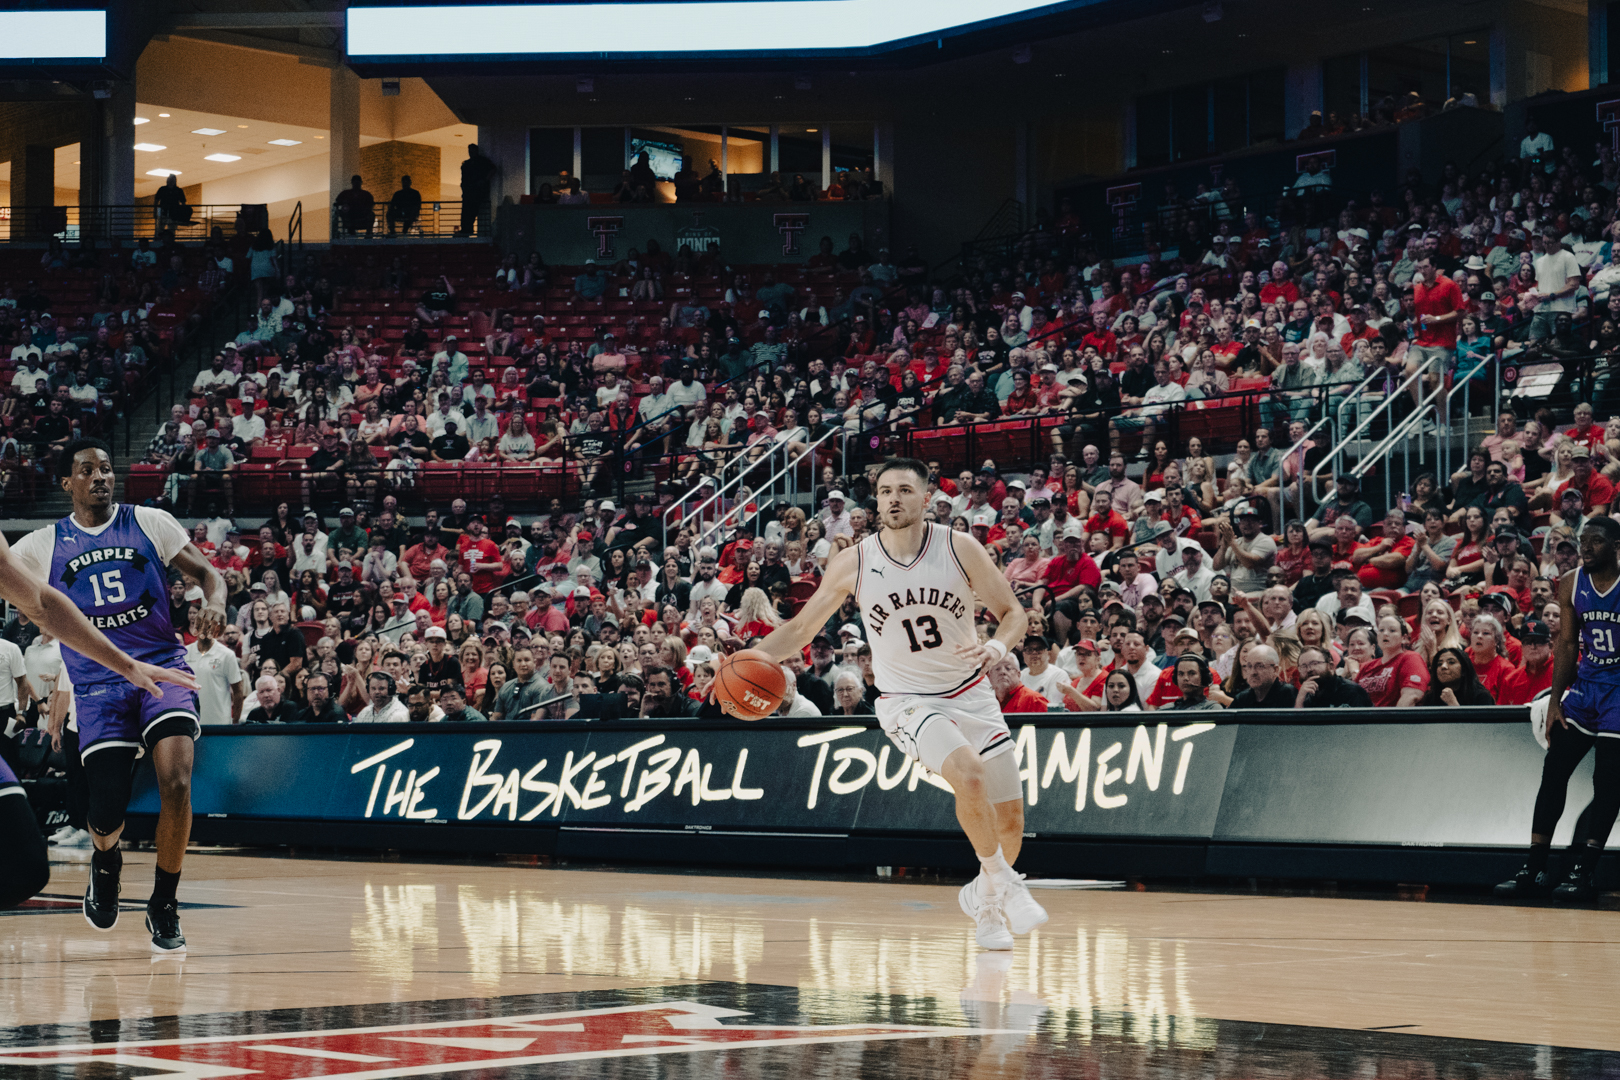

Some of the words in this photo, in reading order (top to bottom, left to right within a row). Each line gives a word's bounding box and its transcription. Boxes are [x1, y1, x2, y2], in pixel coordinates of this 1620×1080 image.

[69, 547, 135, 573] PURPLE
[89, 569, 127, 607] 15
[869, 603, 890, 637] AIR
[888, 587, 966, 620] RAIDERS
[901, 614, 944, 653] 13
[1591, 628, 1615, 652] 21
[457, 734, 764, 821] BASKETBALL
[797, 724, 1217, 811] TOUAMENT
